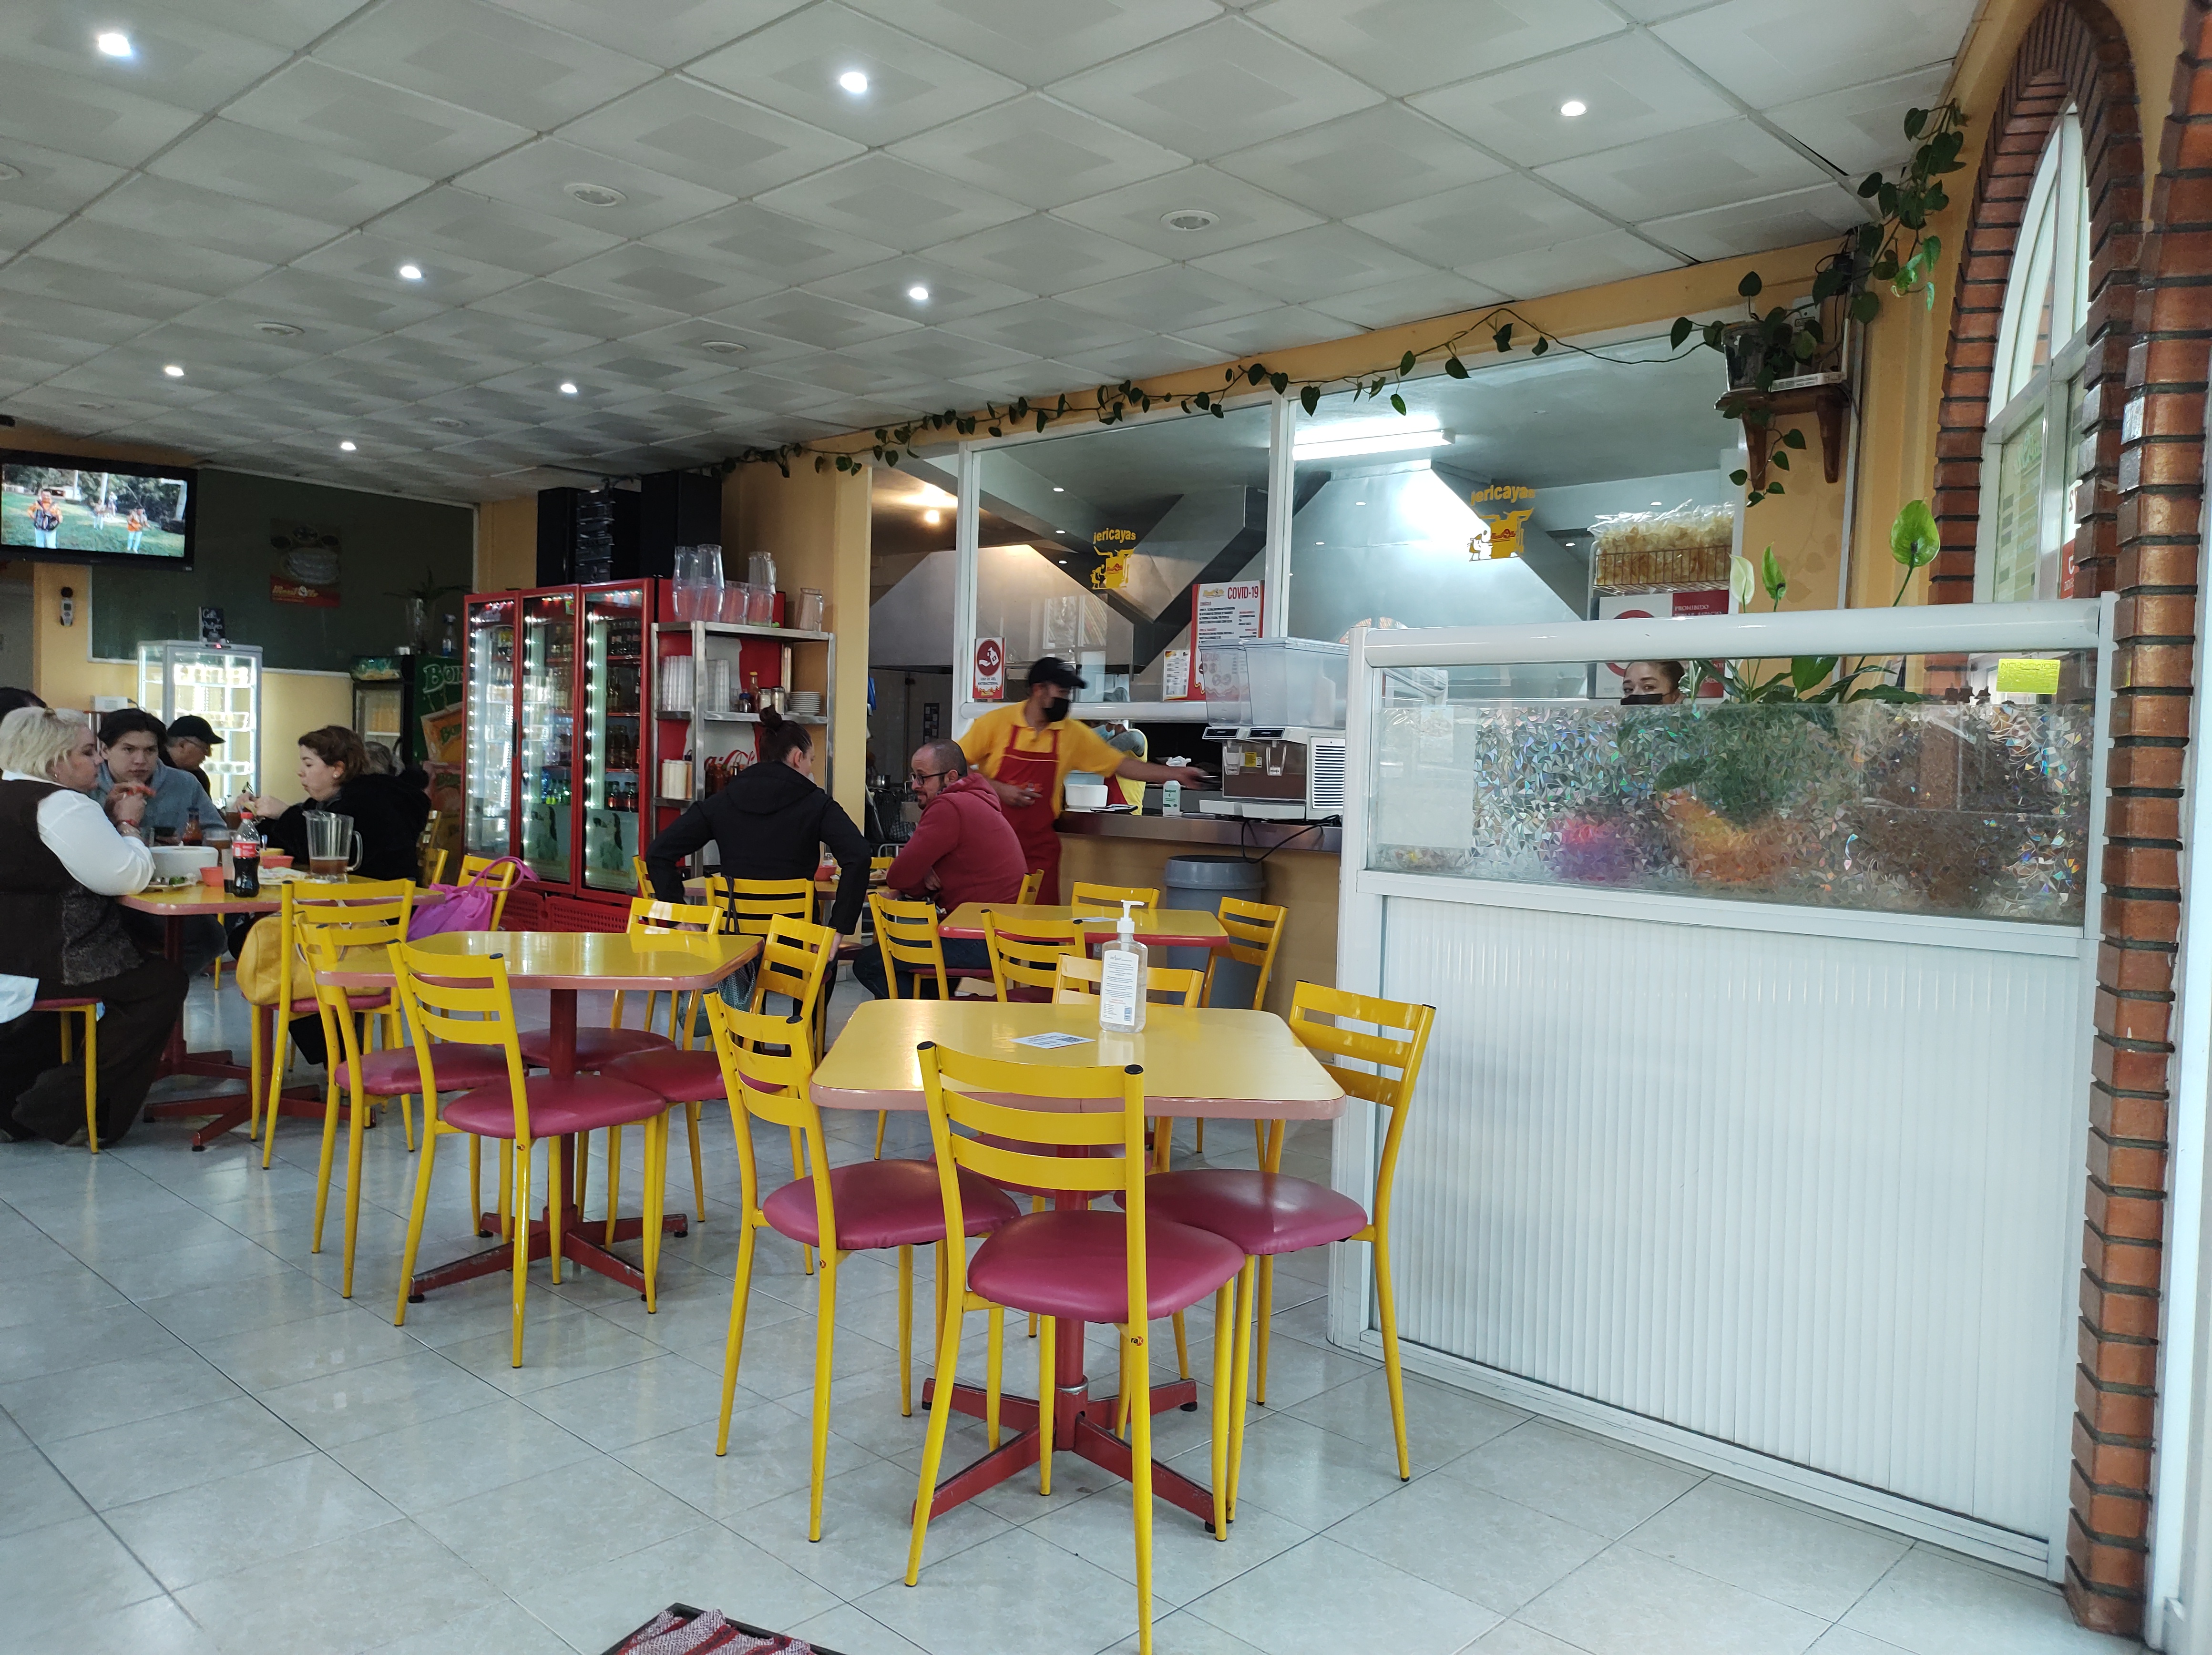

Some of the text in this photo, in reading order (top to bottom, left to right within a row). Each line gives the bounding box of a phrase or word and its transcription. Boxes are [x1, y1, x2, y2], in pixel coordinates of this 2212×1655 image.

[1470, 484, 1536, 506] jericayas
[1093, 528, 1137, 544] jericayas
[1228, 586, 1259, 600] COVID-19
